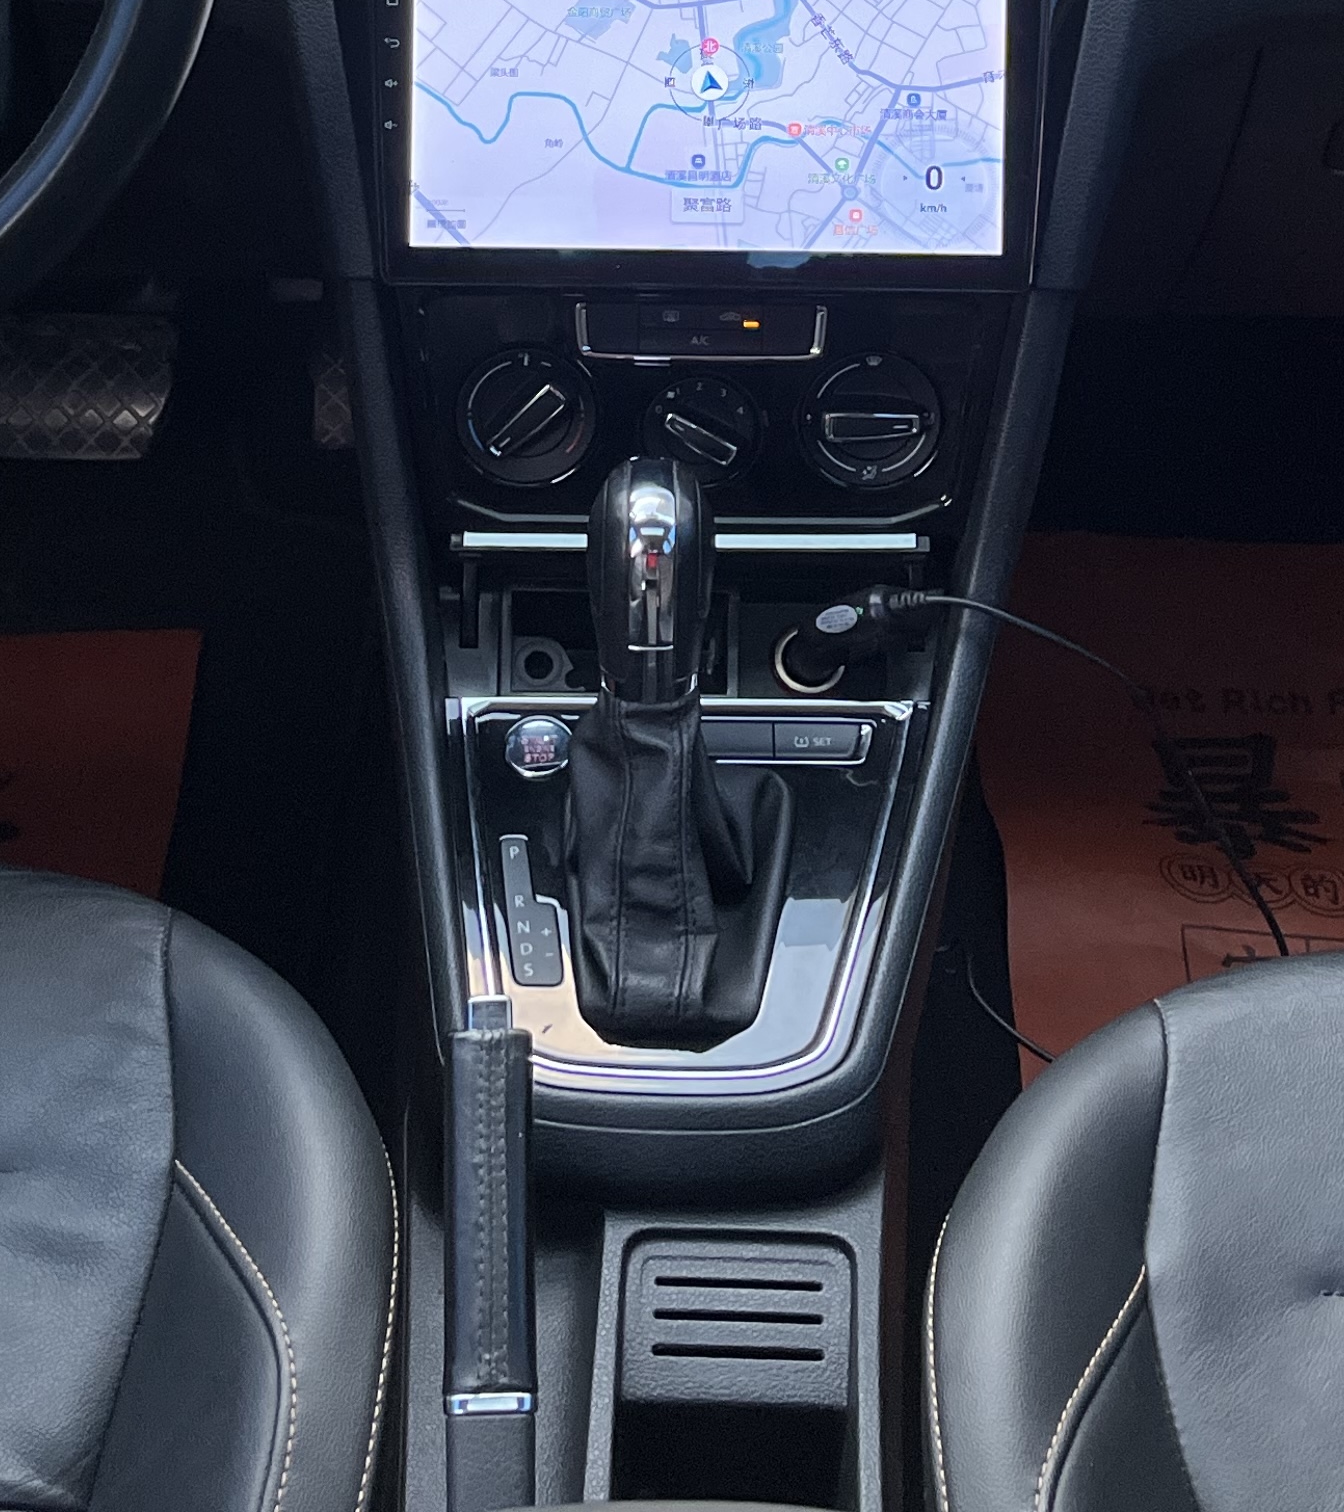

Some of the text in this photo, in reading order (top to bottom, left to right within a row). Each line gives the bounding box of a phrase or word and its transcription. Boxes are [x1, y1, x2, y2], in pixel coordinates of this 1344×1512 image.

[704, 40, 716, 53] 北
[716, 116, 762, 131] 广场路
[924, 164, 944, 191] 0
[682, 196, 732, 213] 聚富路
[919, 201, 948, 214] km/h
[690, 334, 712, 347] A/C
[695, 381, 703, 392] 2
[1221, 686, 1314, 716] Rich
[812, 736, 832, 747] SET
[523, 752, 556, 764] STOP
[508, 845, 520, 860] P
[514, 894, 525, 908] R
[516, 919, 531, 934] N
[520, 941, 534, 956] D
[523, 962, 534, 977] S
